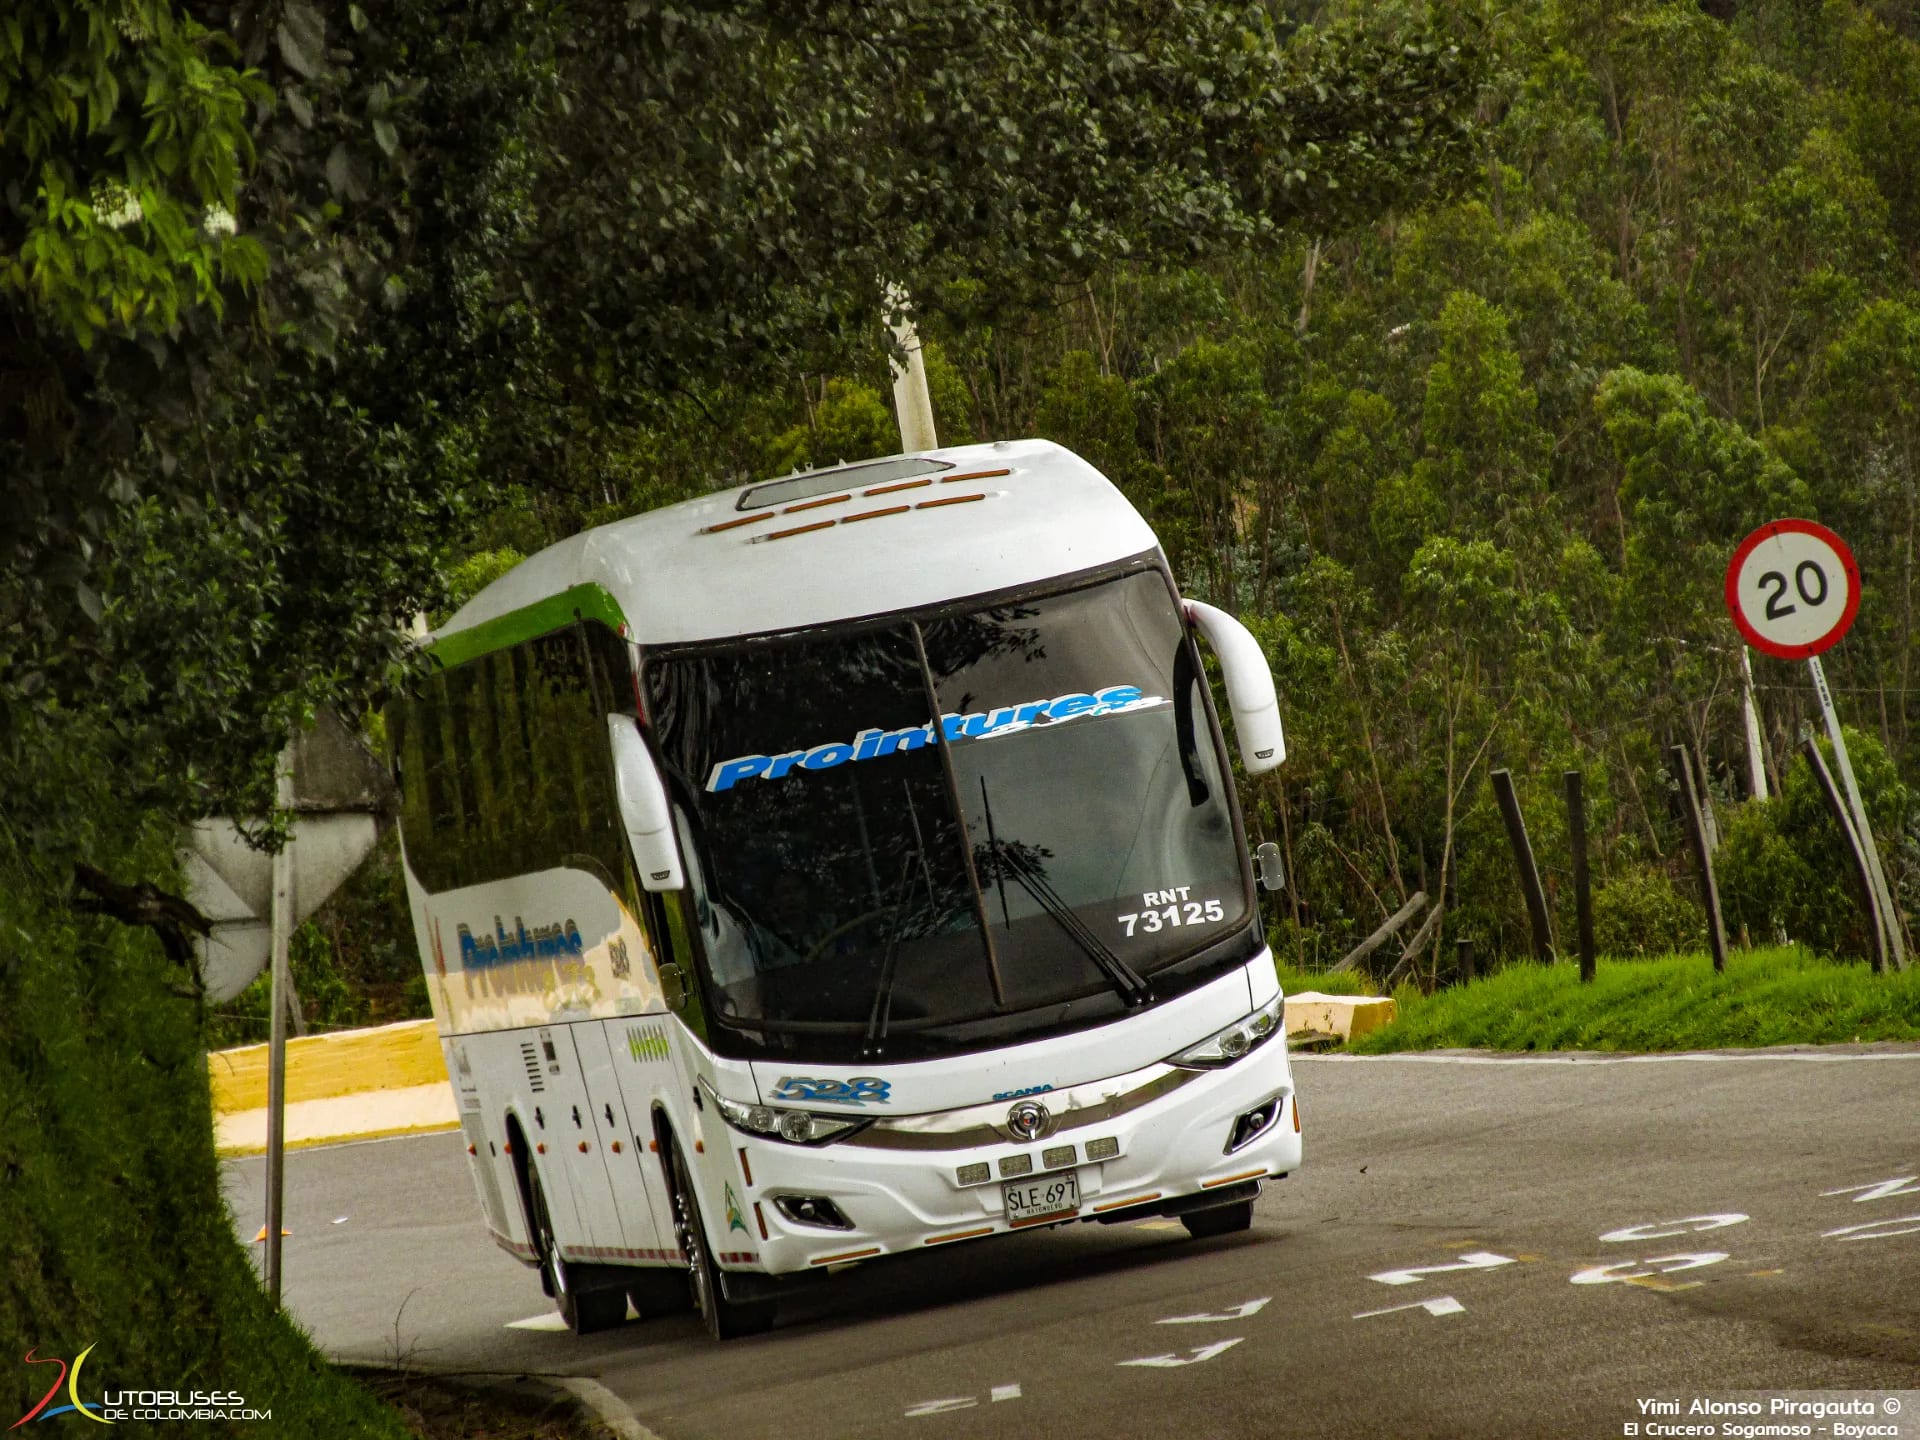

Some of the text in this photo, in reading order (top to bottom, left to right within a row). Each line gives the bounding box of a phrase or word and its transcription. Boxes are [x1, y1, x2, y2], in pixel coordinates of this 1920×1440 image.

[1757, 560, 1828, 621] 20
[705, 684, 1143, 792] Prointures
[1143, 886, 1191, 907] RNT
[1117, 900, 1224, 937] 73125
[769, 1076, 892, 1107] 528
